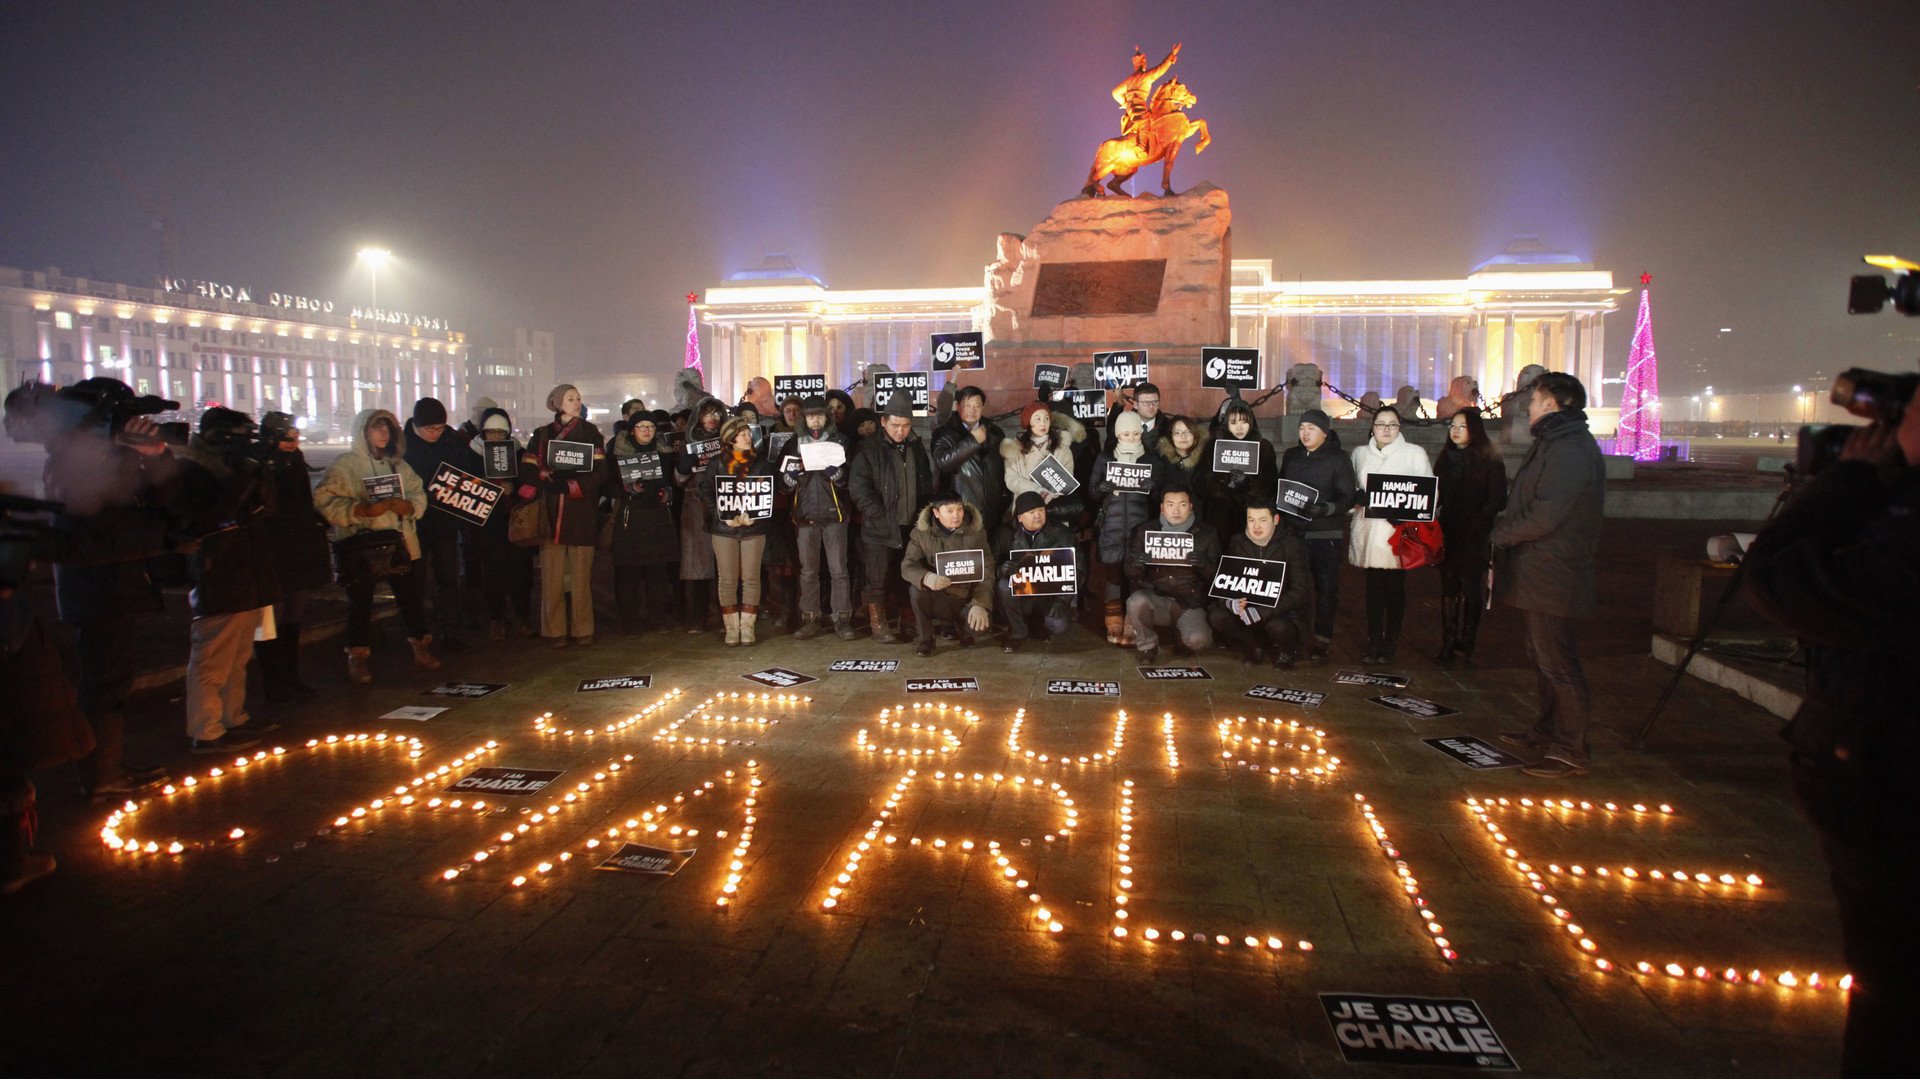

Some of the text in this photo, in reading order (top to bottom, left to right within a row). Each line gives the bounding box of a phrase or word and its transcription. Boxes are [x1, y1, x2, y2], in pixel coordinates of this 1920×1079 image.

[1117, 356, 1127, 364] AM
[1095, 364, 1147, 381] CHARLIE
[775, 378, 824, 390] JE SUIS
[876, 376, 926, 389] JE SUIS
[1038, 375, 1060, 383] CHARLIE
[1076, 395, 1085, 403] AM
[697, 440, 720, 453] JE SUIS
[500, 446, 508, 472] CHARLIE
[555, 456, 584, 466] CHARLIE
[1221, 456, 1250, 465] CHARLIE
[1107, 467, 1151, 478] JE SUIS
[1053, 473, 1067, 488] SUIS
[437, 471, 498, 502] JE SUIS
[718, 481, 771, 493] JE SUIS
[1382, 481, 1418, 492] НАМАЙГ
[718, 494, 771, 511] CHARLIE
[1294, 492, 1309, 503] SUIS
[1369, 491, 1428, 510] ШАРЛИ
[1146, 537, 1193, 548] JE SUIS
[956, 560, 975, 568] SUIS
[1039, 555, 1050, 563] AM
[945, 566, 975, 576] CHARLIE
[1243, 566, 1259, 576] I AM
[1214, 574, 1280, 598] CHARLIE
[583, 680, 644, 689] ШАРЛИ
[907, 682, 977, 690] CHARLIE
[1048, 686, 1118, 694] CHARLIE
[1249, 689, 1322, 704] CHARLIE
[1282, 688, 1323, 698] SUIS
[456, 777, 548, 790] CHARLIE
[1332, 1001, 1480, 1025] JE SUIS
[1335, 1022, 1504, 1054] CHARLIE
